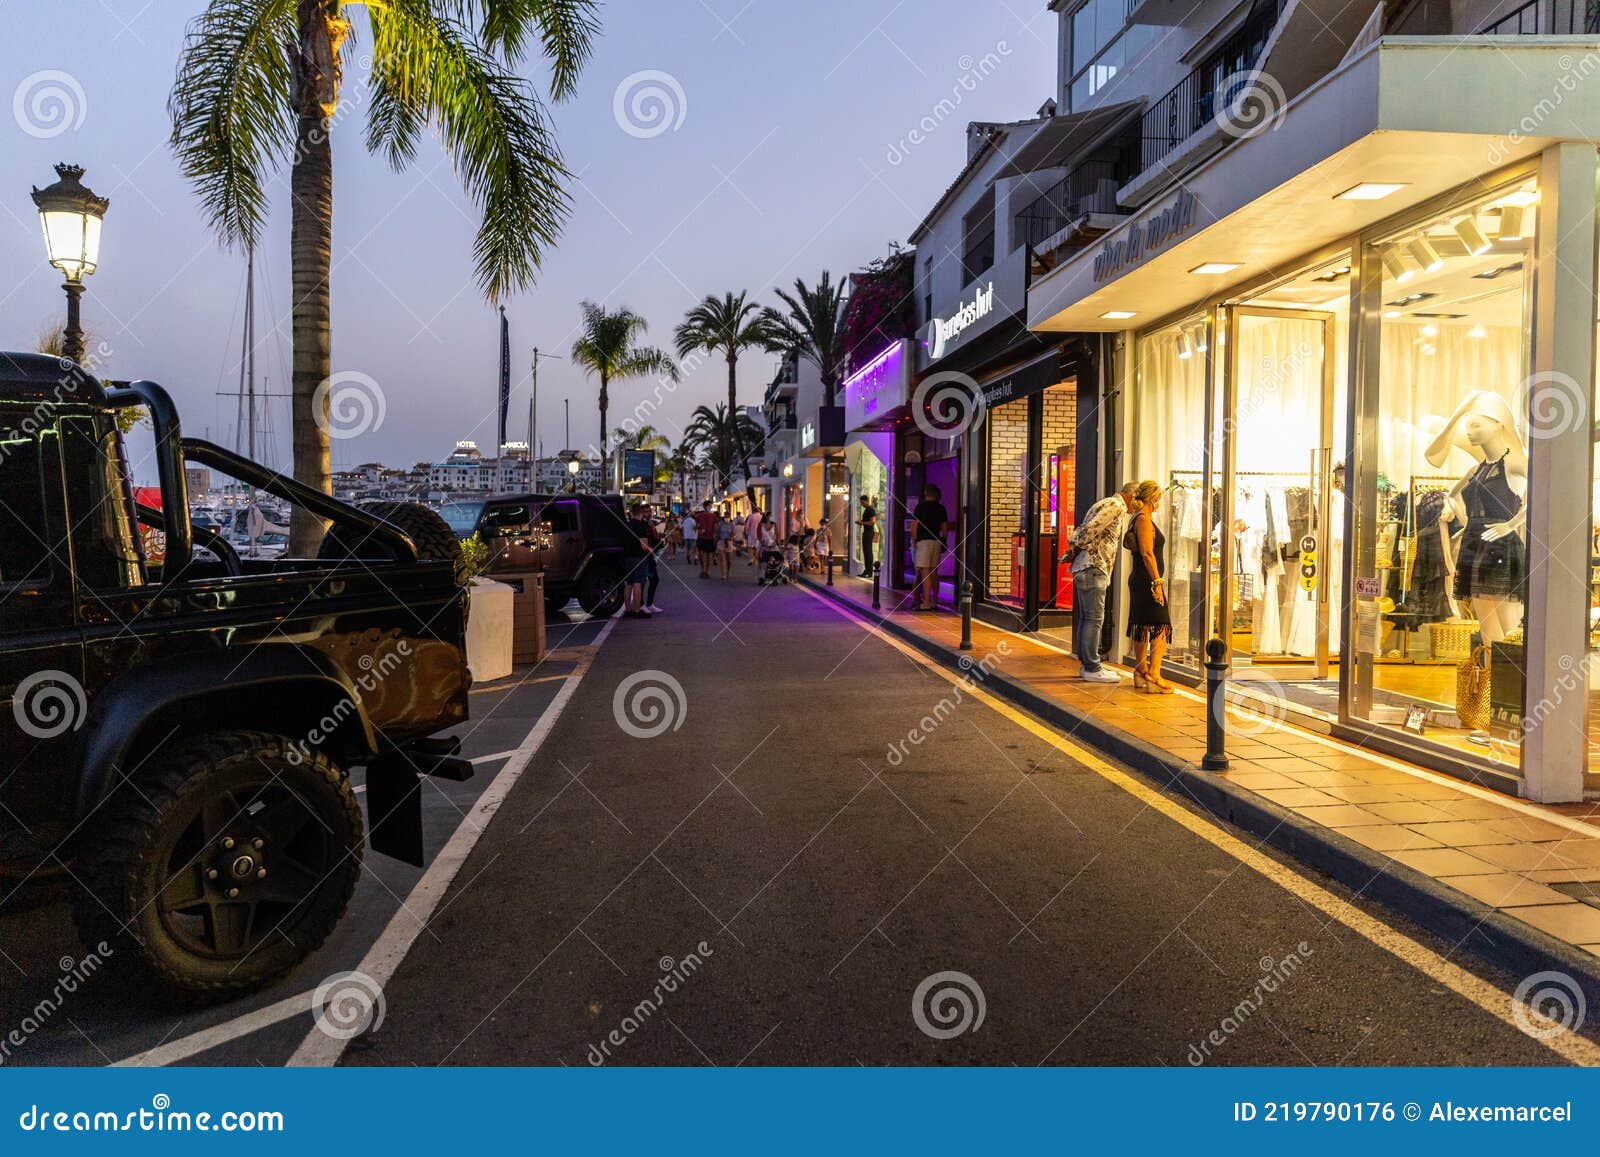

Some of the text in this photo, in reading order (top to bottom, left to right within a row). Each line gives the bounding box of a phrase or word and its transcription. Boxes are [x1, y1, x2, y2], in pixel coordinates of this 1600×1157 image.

[943, 281, 994, 342] sunglass hut
[456, 440, 477, 449] HOTEL
